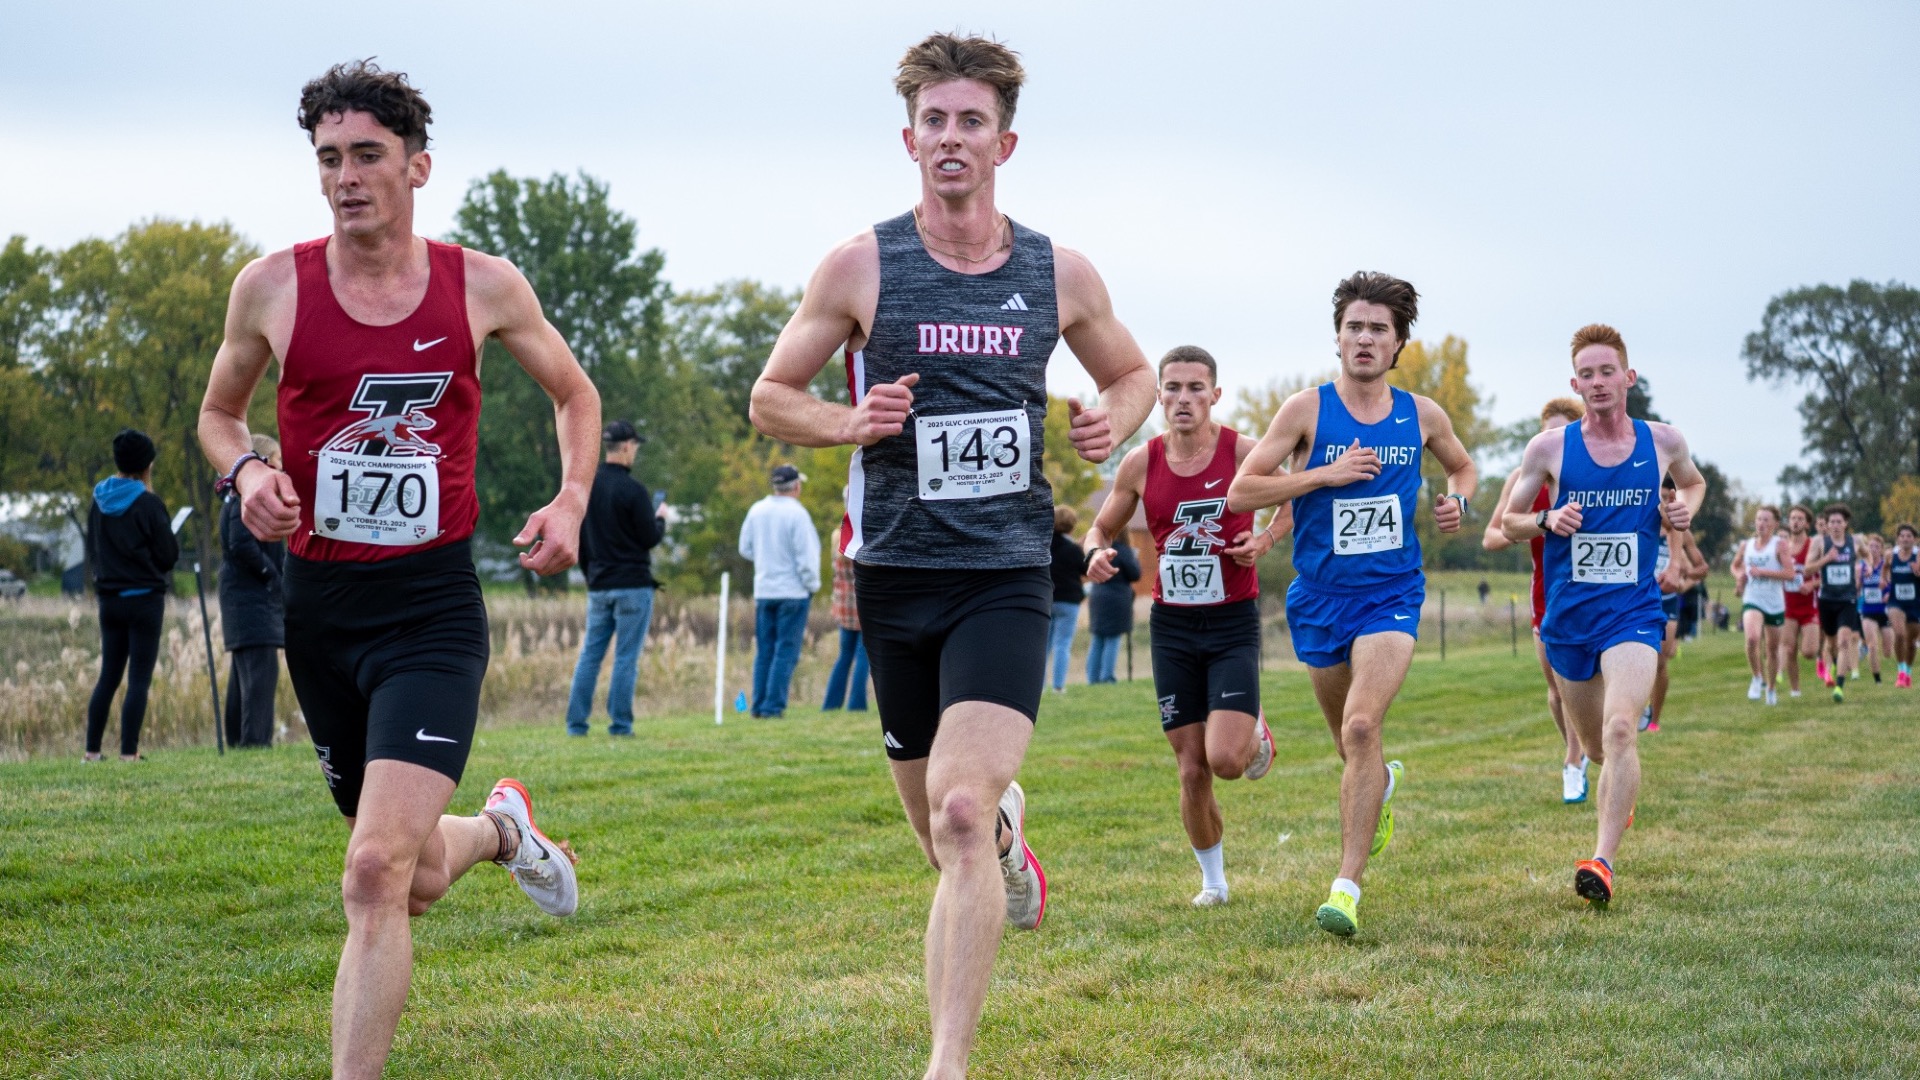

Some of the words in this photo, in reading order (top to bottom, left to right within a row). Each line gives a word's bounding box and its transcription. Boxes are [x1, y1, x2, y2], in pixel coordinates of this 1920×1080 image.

[918, 323, 1023, 356] DRURY
[963, 415, 1018, 426] CHAMPIONSHIPS
[931, 425, 1020, 472] 143
[330, 457, 346, 466] 2025
[348, 459, 366, 468] GLVC
[367, 461, 427, 470] CHAMPIONSHIPS
[331, 468, 427, 519] 170
[1567, 488, 1653, 508] ROCKHURST
[346, 516, 378, 525] OCTOBER
[378, 519, 389, 527] 25,
[1339, 505, 1397, 536] 274
[1578, 541, 1632, 567] 270
[1166, 563, 1214, 589] 167
